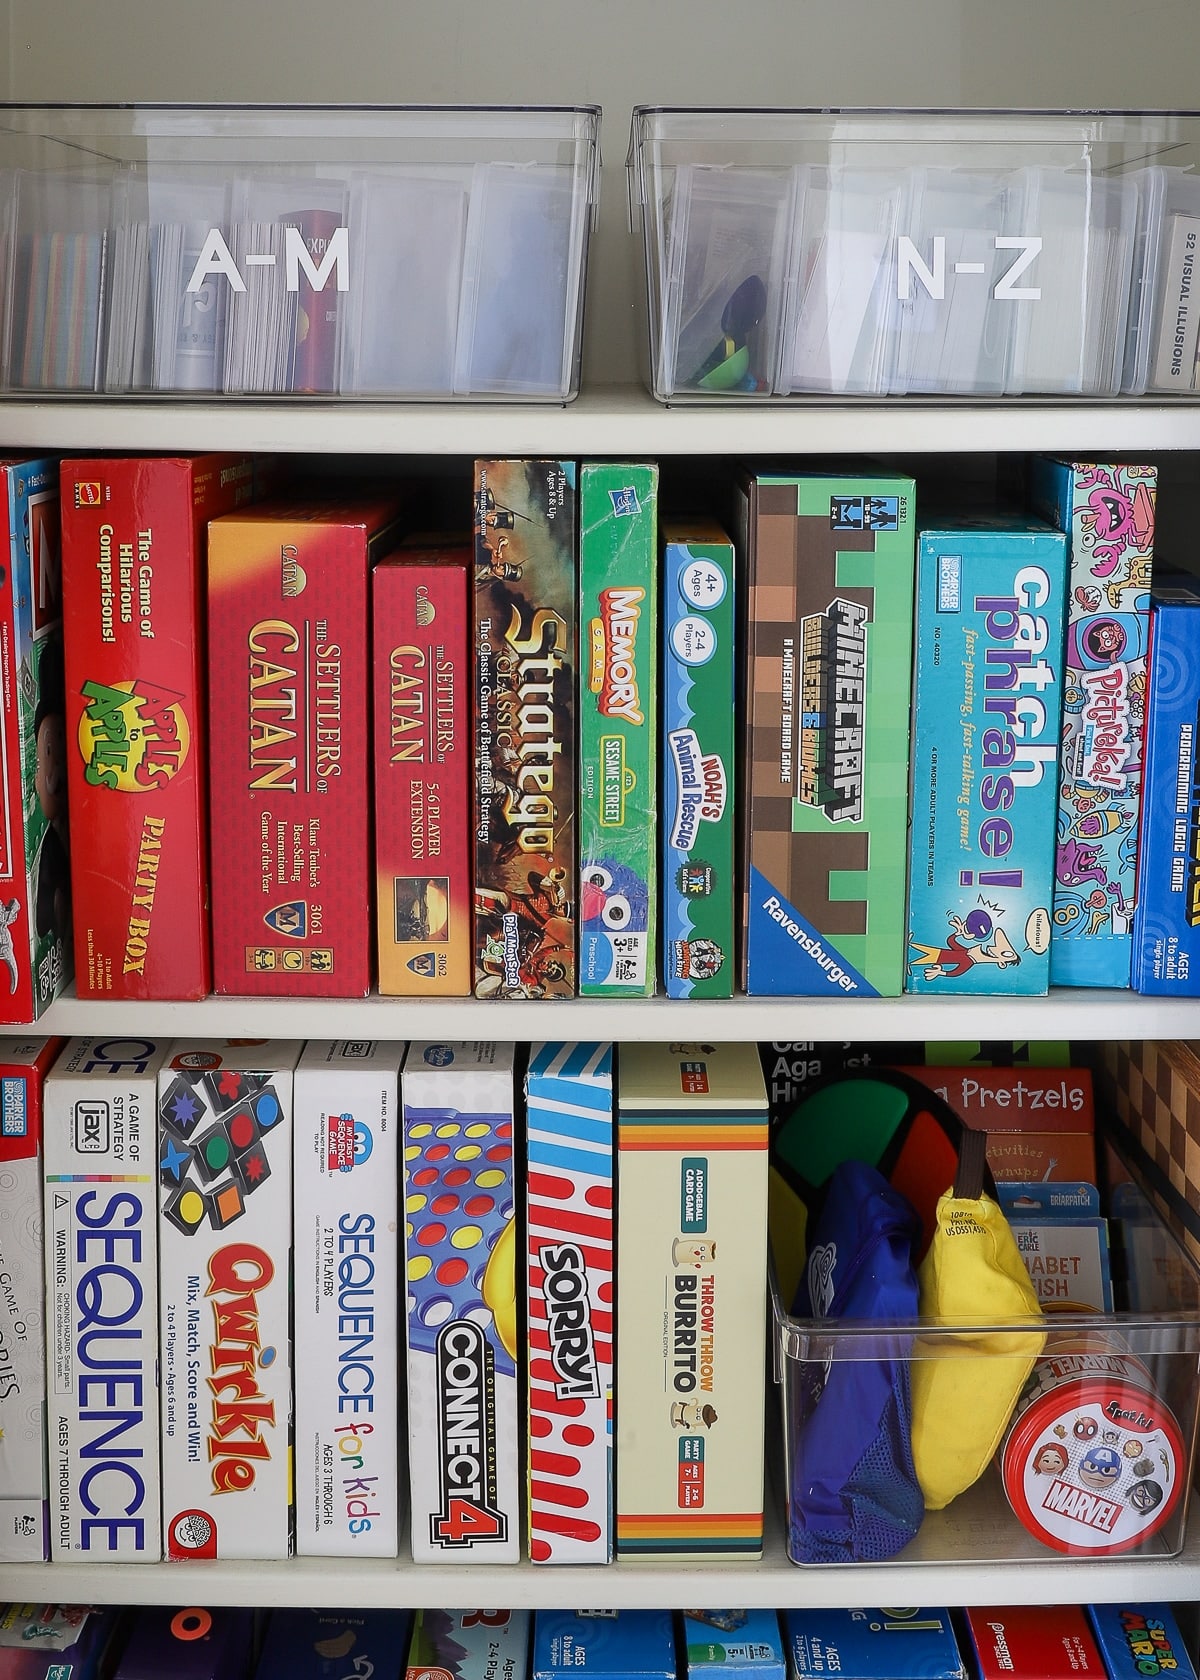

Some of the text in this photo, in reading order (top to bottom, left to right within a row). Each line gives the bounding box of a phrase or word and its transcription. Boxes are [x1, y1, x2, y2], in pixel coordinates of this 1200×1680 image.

[187, 228, 349, 292] A-M
[898, 236, 1043, 300] N-Z
[84, 484, 98, 504] MATTEL
[479, 470, 488, 536] www.stratego.com
[546, 471, 556, 490] Ages
[556, 478, 566, 506] Players
[546, 506, 557, 519] Up
[97, 525, 116, 642] Comparisons!
[119, 544, 134, 622] Hilarious
[138, 529, 155, 638] The Game of
[692, 570, 703, 598] Ages
[940, 558, 950, 609] BROTHERS
[949, 572, 959, 609] PARKER
[594, 628, 603, 684] GAME
[684, 624, 694, 658] Players
[695, 631, 706, 650] 2-4
[782, 649, 794, 712] MINECRAFT
[1011, 566, 1059, 788] catch
[248, 620, 300, 794] CATAN
[316, 620, 342, 794] THE SETTLERS OF
[390, 646, 426, 763] CATAN
[436, 646, 454, 764] THE SETTLERS OF
[800, 616, 822, 806] BUILDERS & BIOMES
[832, 601, 866, 822] MINECRAFT
[1086, 669, 1125, 785] Pictureka!
[81, 680, 136, 790] APPLES
[130, 728, 142, 742] to
[134, 680, 186, 790] APPLES
[503, 604, 568, 856] Stratego
[781, 714, 793, 750] BOARD
[781, 752, 792, 783] GAME
[930, 766, 938, 788] MORE
[931, 754, 938, 764] OR
[1176, 725, 1193, 814] PROGRAMMING
[674, 735, 704, 849] Animal Rescue
[929, 790, 937, 815] ADULT
[410, 780, 424, 860] EXTENSION
[928, 816, 936, 850] PLAYERS
[1174, 819, 1186, 852] LOGIC
[261, 812, 273, 894] Game of the Year
[277, 821, 288, 884] International
[290, 824, 304, 882] Best-Selling
[308, 818, 320, 888] Klaus Teuber's
[927, 860, 935, 887] TEAMS
[928, 851, 936, 860] IN
[1170, 858, 1185, 892] GAME
[122, 816, 166, 976] PARTY BOX
[704, 867, 712, 894] Cooperative
[762, 896, 858, 992] Ravensburger
[1035, 914, 1044, 948] hilarious!
[88, 957, 95, 965] 30
[88, 966, 96, 990] Minutes
[438, 954, 448, 977] 3062
[588, 938, 598, 980] Preschool
[1153, 940, 1164, 979] single player
[1177, 952, 1190, 980] AGES
[4, 1081, 14, 1134] BROTHERS
[14, 1095, 24, 1133] PARKER
[961, 1078, 1085, 1111] Pretzels
[113, 1097, 124, 1161] STRATEGY
[129, 1094, 140, 1162] A GAME OF
[329, 1130, 338, 1154] GAME
[337, 1120, 346, 1166] SEQUENCE
[346, 1126, 354, 1159] MY FIRST
[686, 1169, 694, 1222] CARD GAME
[696, 1175, 704, 1222] DODGEBALL
[56, 1229, 67, 1288] WARNING:
[1018, 1243, 1040, 1252] CARLE
[167, 1312, 175, 1323] to
[542, 1244, 598, 1400] SORRY!
[674, 1275, 698, 1393] BURRITO
[700, 1275, 715, 1392] THROW THROW
[76, 1190, 146, 1551] SEQUENCE
[166, 1333, 176, 1366] Players
[204, 1242, 278, 1496] Qwirkle
[1052, 1354, 1129, 1378] MARVEL
[166, 1373, 176, 1396] Ages
[334, 1213, 381, 1534] SEQUENCE for kids
[58, 1416, 69, 1447] AGES
[166, 1424, 174, 1437] up
[167, 1405, 176, 1422] and
[439, 1326, 500, 1542] CONNECT 4
[486, 1350, 496, 1501] THE ORIGINAL GAME OF
[324, 1444, 334, 1466] AGES
[59, 1458, 70, 1511] THROUGH
[324, 1476, 334, 1518] THROUGH
[1042, 1480, 1124, 1534] MARVEL
[60, 1514, 70, 1550] ADULT
[575, 1646, 586, 1666] AGES
[812, 1643, 823, 1659] and
[814, 1660, 824, 1671] up
[1078, 1653, 1088, 1670] Players
[1121, 1609, 1161, 1677] MARIO
[1146, 1618, 1180, 1671] SUPER
